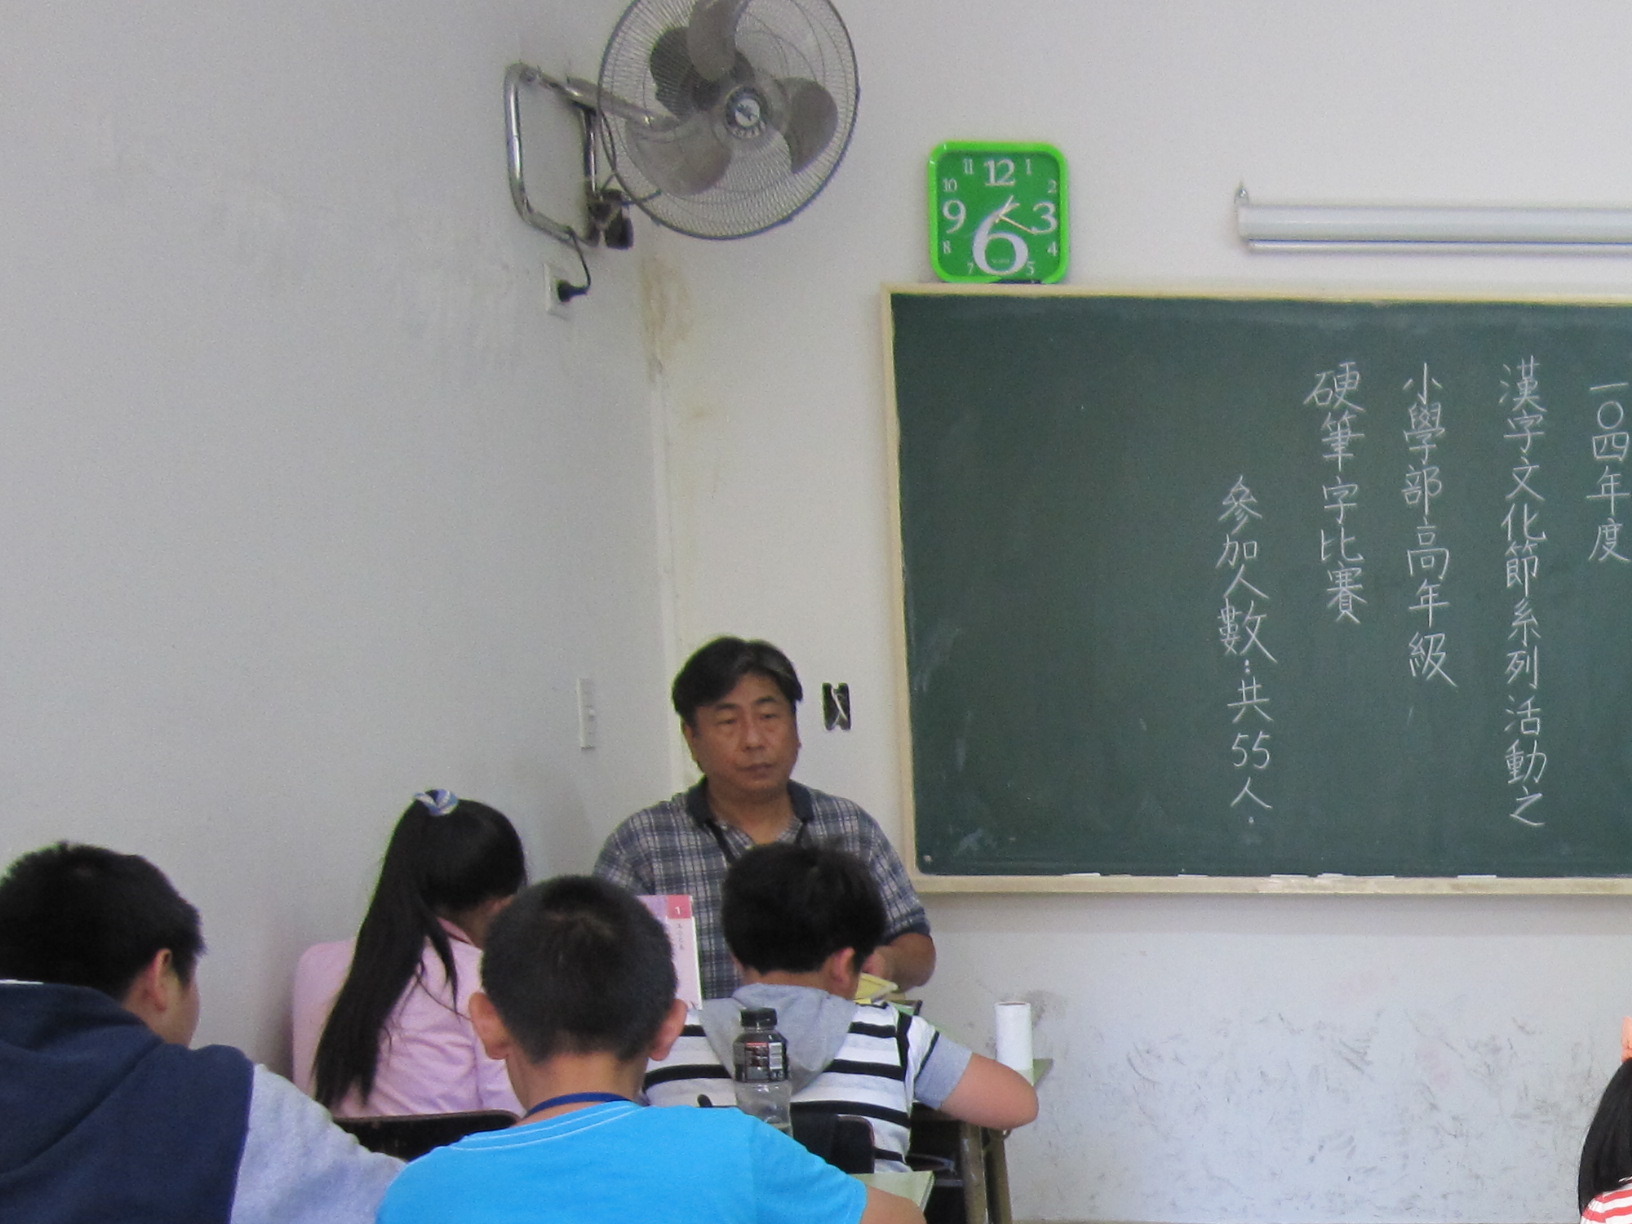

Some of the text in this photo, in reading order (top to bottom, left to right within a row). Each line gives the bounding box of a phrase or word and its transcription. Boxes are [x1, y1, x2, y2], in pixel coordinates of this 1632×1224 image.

[963, 158, 974, 175] 11
[983, 158, 1016, 186] 12
[1025, 158, 1032, 175] 1
[942, 178, 957, 192] 10
[1047, 180, 1057, 194] 2
[942, 200, 967, 233] 9
[1032, 201, 1058, 235] 3
[943, 241, 951, 254] 8
[972, 203, 1029, 276] 6
[1047, 241, 1058, 257] 4
[967, 262, 974, 274] 7
[1027, 261, 1036, 276] 5
[1303, 361, 1368, 625] 硬筆字比賽
[1402, 362, 1458, 687] 小學部高年級
[1498, 355, 1547, 827] 漢字文化節系列活動之
